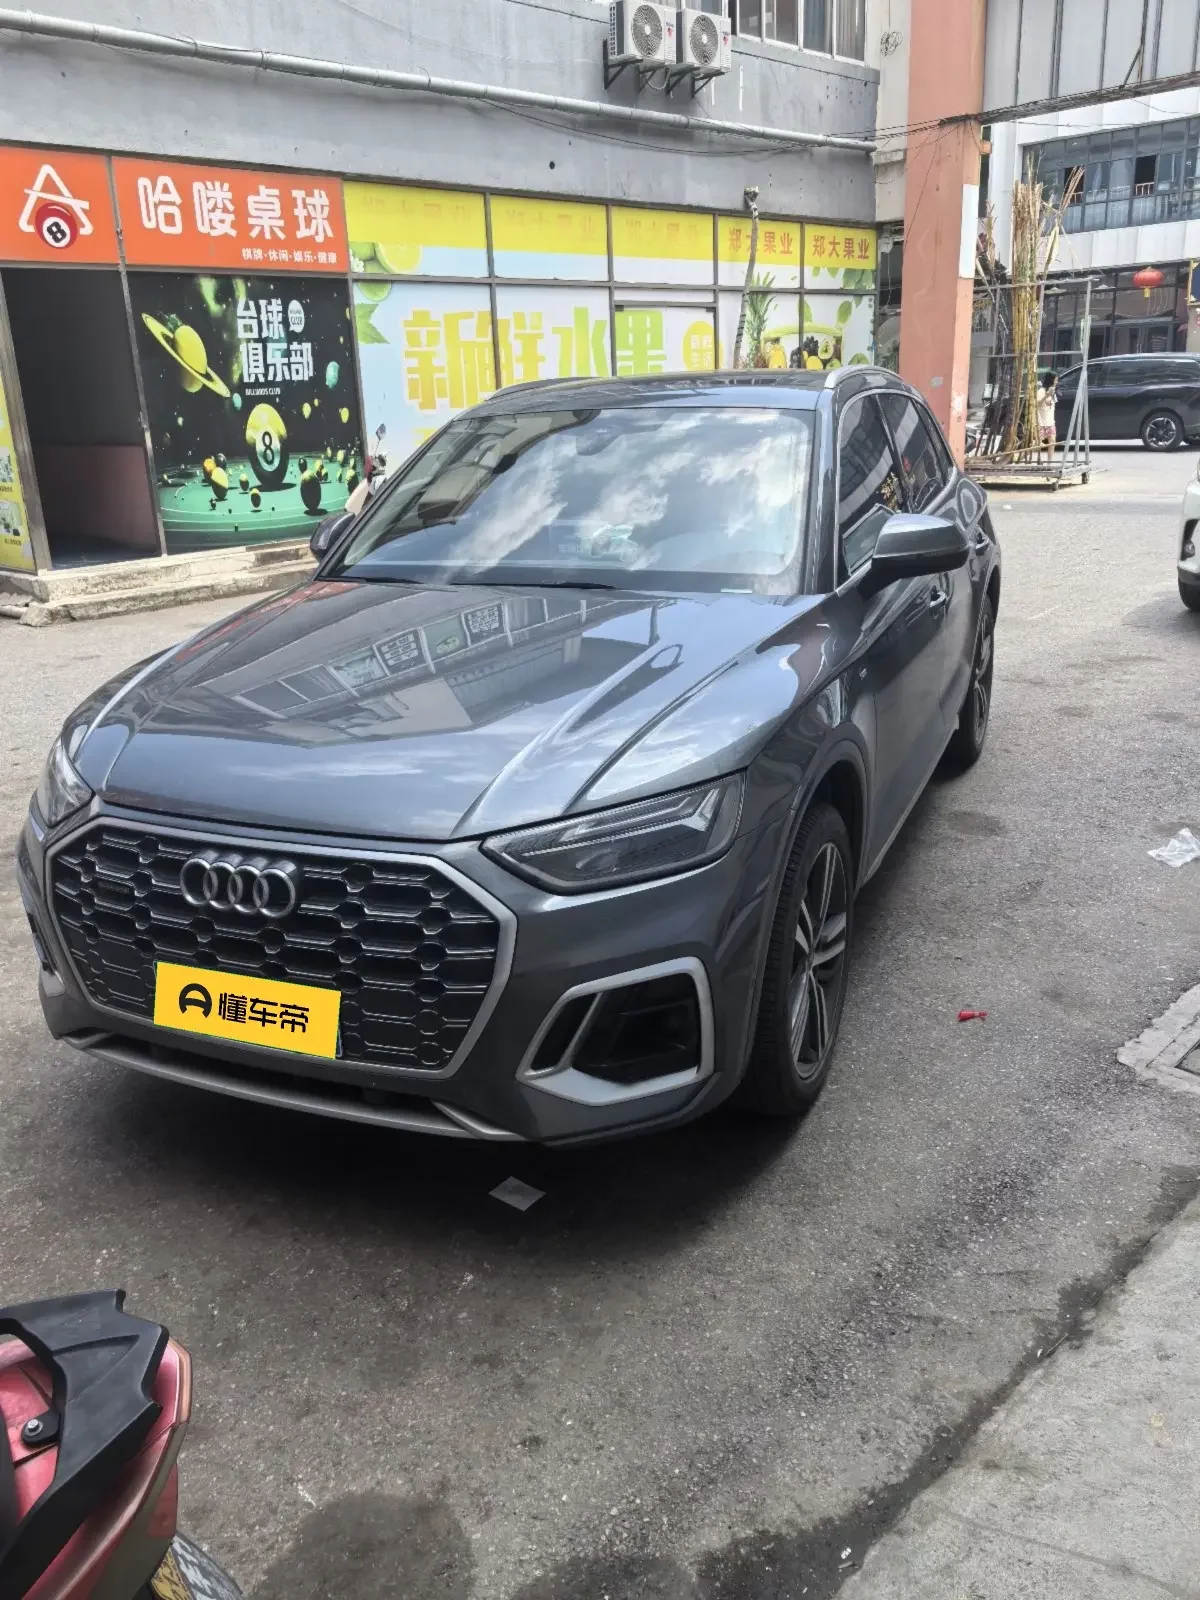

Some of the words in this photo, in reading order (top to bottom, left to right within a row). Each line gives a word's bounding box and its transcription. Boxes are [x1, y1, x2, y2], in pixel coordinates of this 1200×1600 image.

[137, 175, 335, 243] 哈喽桌球
[812, 234, 870, 260] 郑大果业
[236, 297, 286, 340] 台球
[240, 341, 314, 383] 俱乐部
[402, 306, 668, 410] 新鲜水果
